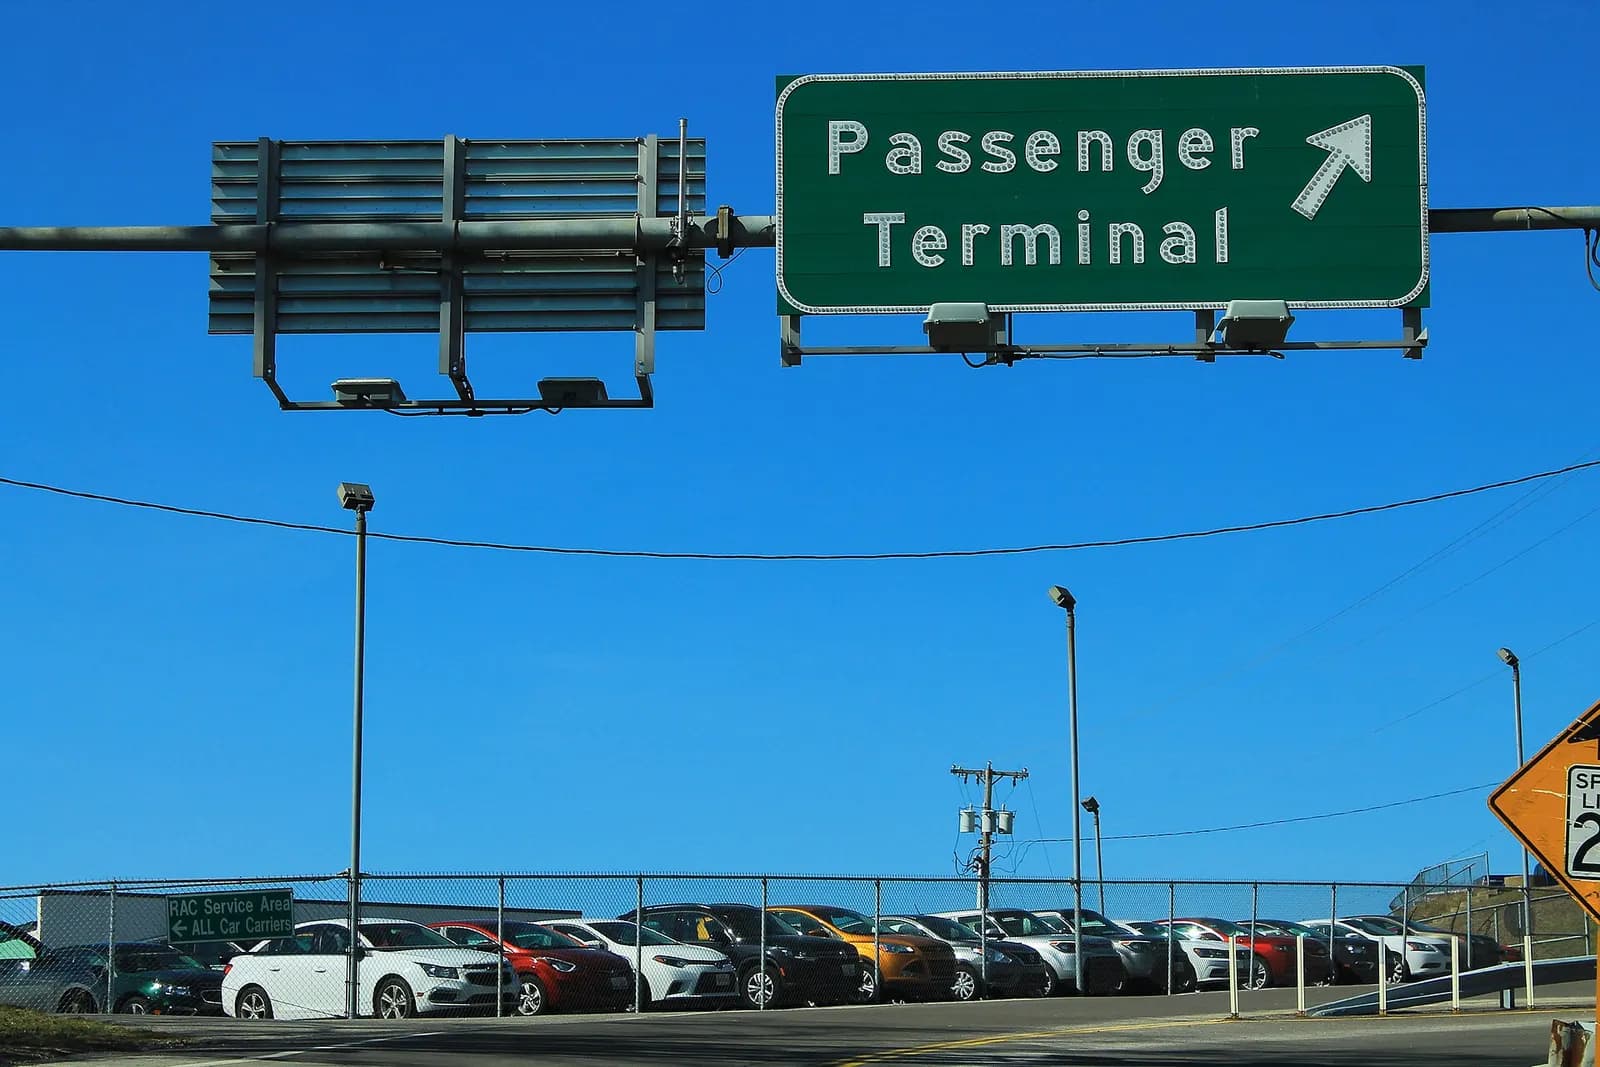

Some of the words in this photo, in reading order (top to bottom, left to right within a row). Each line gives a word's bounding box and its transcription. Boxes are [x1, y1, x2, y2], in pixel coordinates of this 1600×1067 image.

[828, 120, 1260, 194] Passenger
[863, 206, 1229, 267] Terminal
[169, 899, 198, 917] RAC
[204, 898, 254, 915] Service
[260, 895, 290, 912] Area
[192, 919, 215, 936] ALL
[219, 917, 240, 934] Car
[245, 916, 292, 933] Carriers
